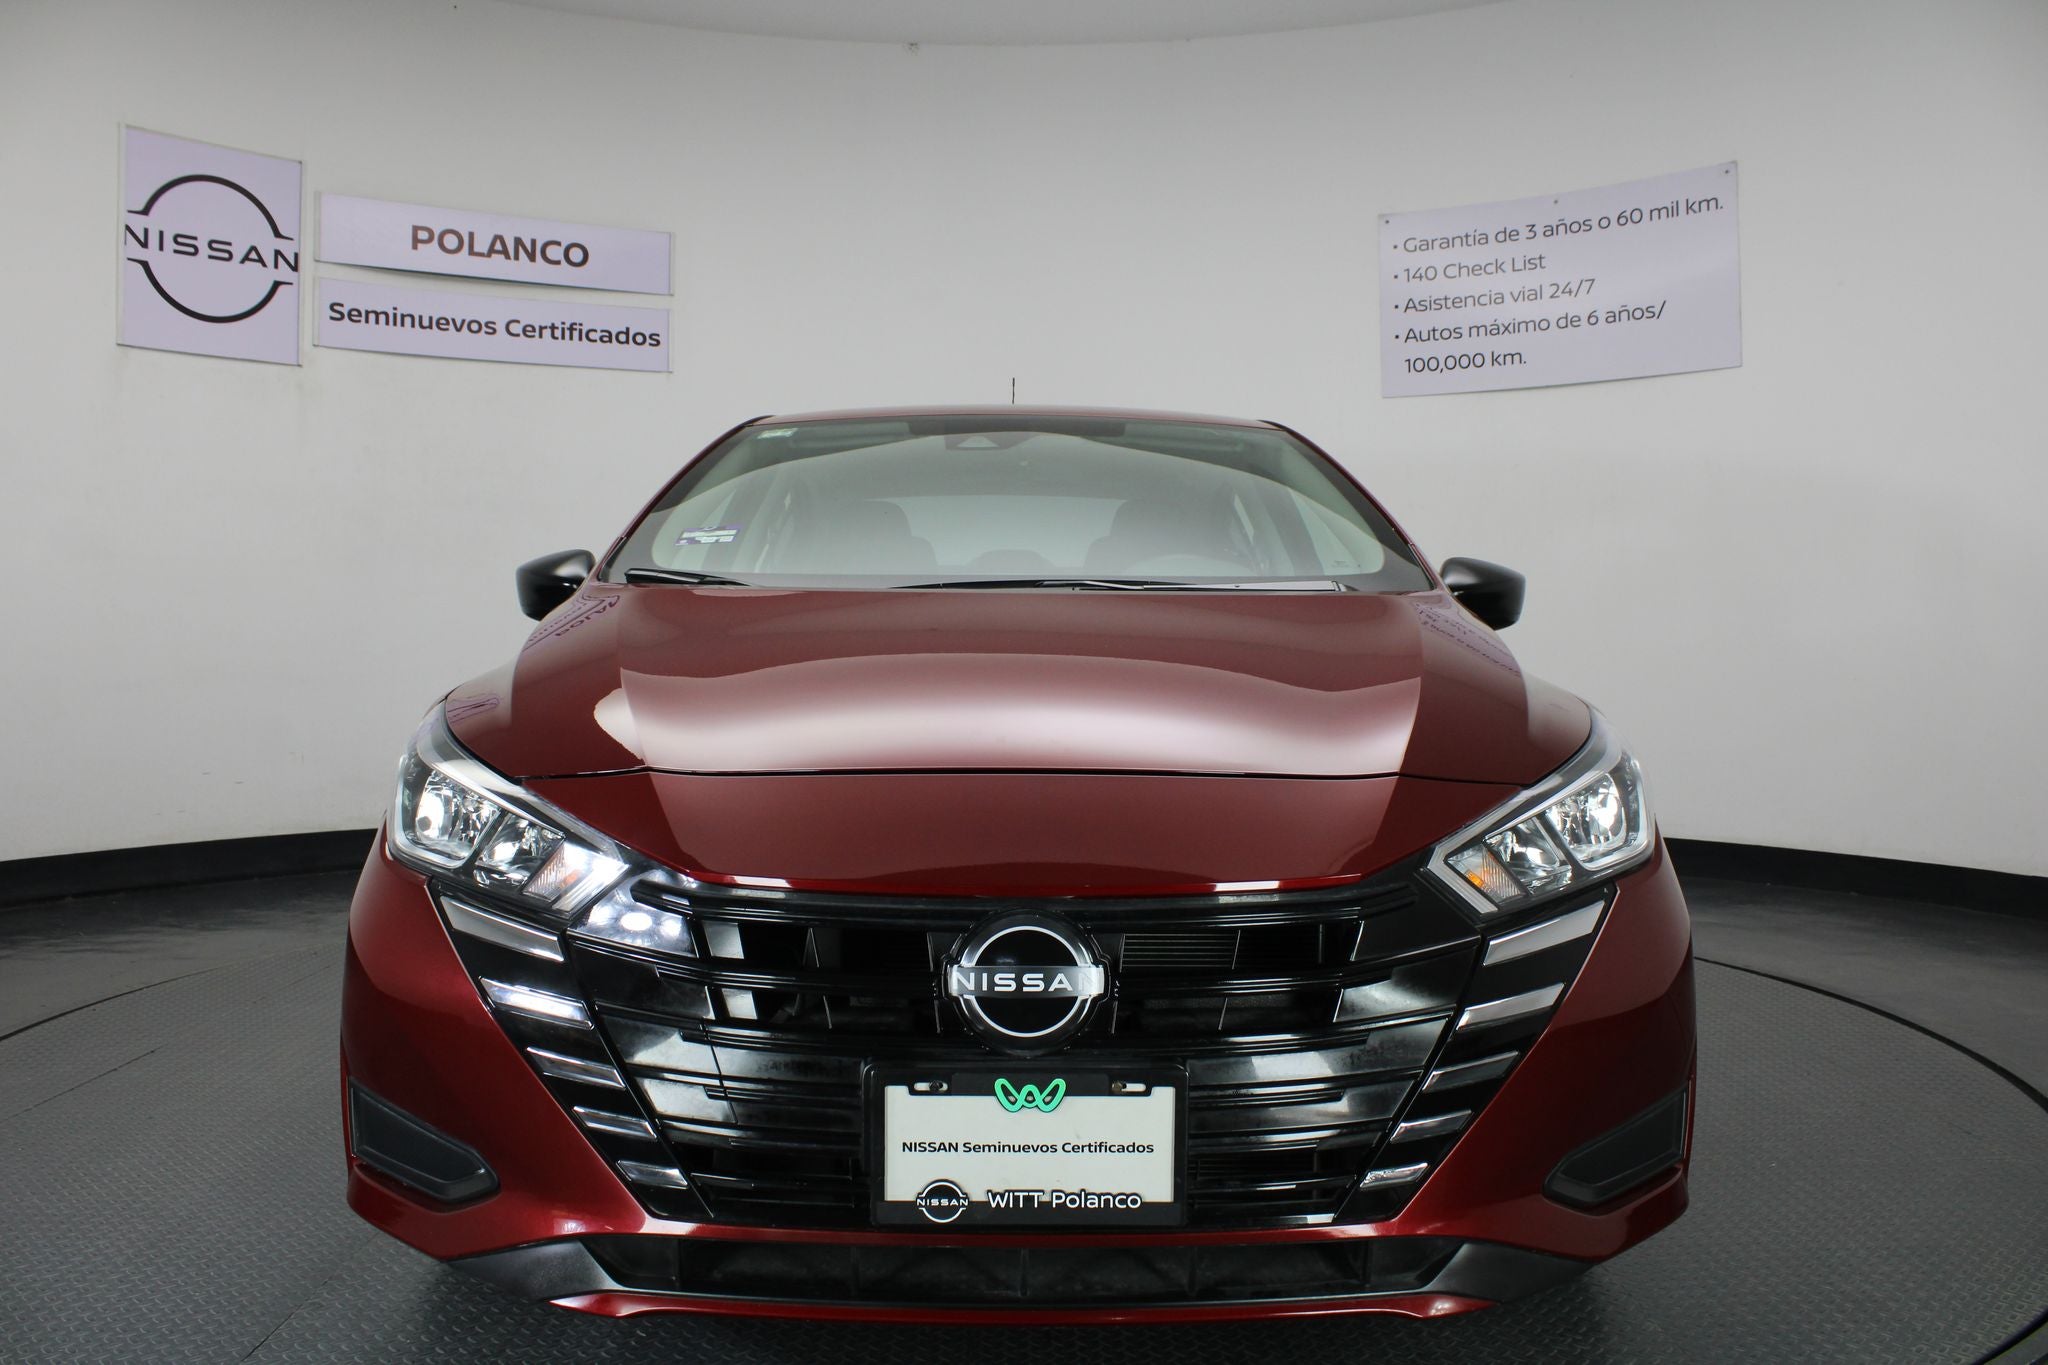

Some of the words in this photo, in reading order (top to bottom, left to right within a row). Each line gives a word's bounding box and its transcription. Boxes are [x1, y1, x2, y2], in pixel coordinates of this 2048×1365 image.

[1402, 229, 1490, 253] Garantía
[1494, 226, 1520, 244] de
[1525, 224, 1537, 241] 3
[1542, 217, 1593, 238] años
[1598, 215, 1611, 230] o
[1616, 207, 1644, 228] 60
[1649, 200, 1680, 222] mil
[1685, 195, 1724, 216] km.
[124, 223, 299, 274] NISSAN
[410, 224, 591, 269] POLANCO
[1403, 265, 1438, 284] 140
[1443, 259, 1507, 280] Check
[1511, 253, 1547, 272] List
[1403, 289, 1505, 314] Asistencia
[1510, 285, 1543, 303] vial
[1549, 278, 1596, 300] 24/7
[327, 301, 498, 337] Seminuevos
[504, 318, 662, 349] Certificados
[1403, 324, 1463, 344] Autos
[1467, 317, 1551, 340] máximo
[1555, 313, 1582, 330] de
[1587, 310, 1599, 326] 6
[1604, 300, 1667, 325] años/
[1404, 352, 1486, 375] 100,000
[1490, 350, 1527, 368] km.
[901, 1141, 959, 1153] NISSAN
[962, 1141, 1058, 1153] Seminuevos
[1061, 1141, 1155, 1153] Certificados
[916, 1197, 969, 1206] NISSAN
[987, 1191, 1044, 1209] WITT
[1051, 1190, 1141, 1209] Polanco
